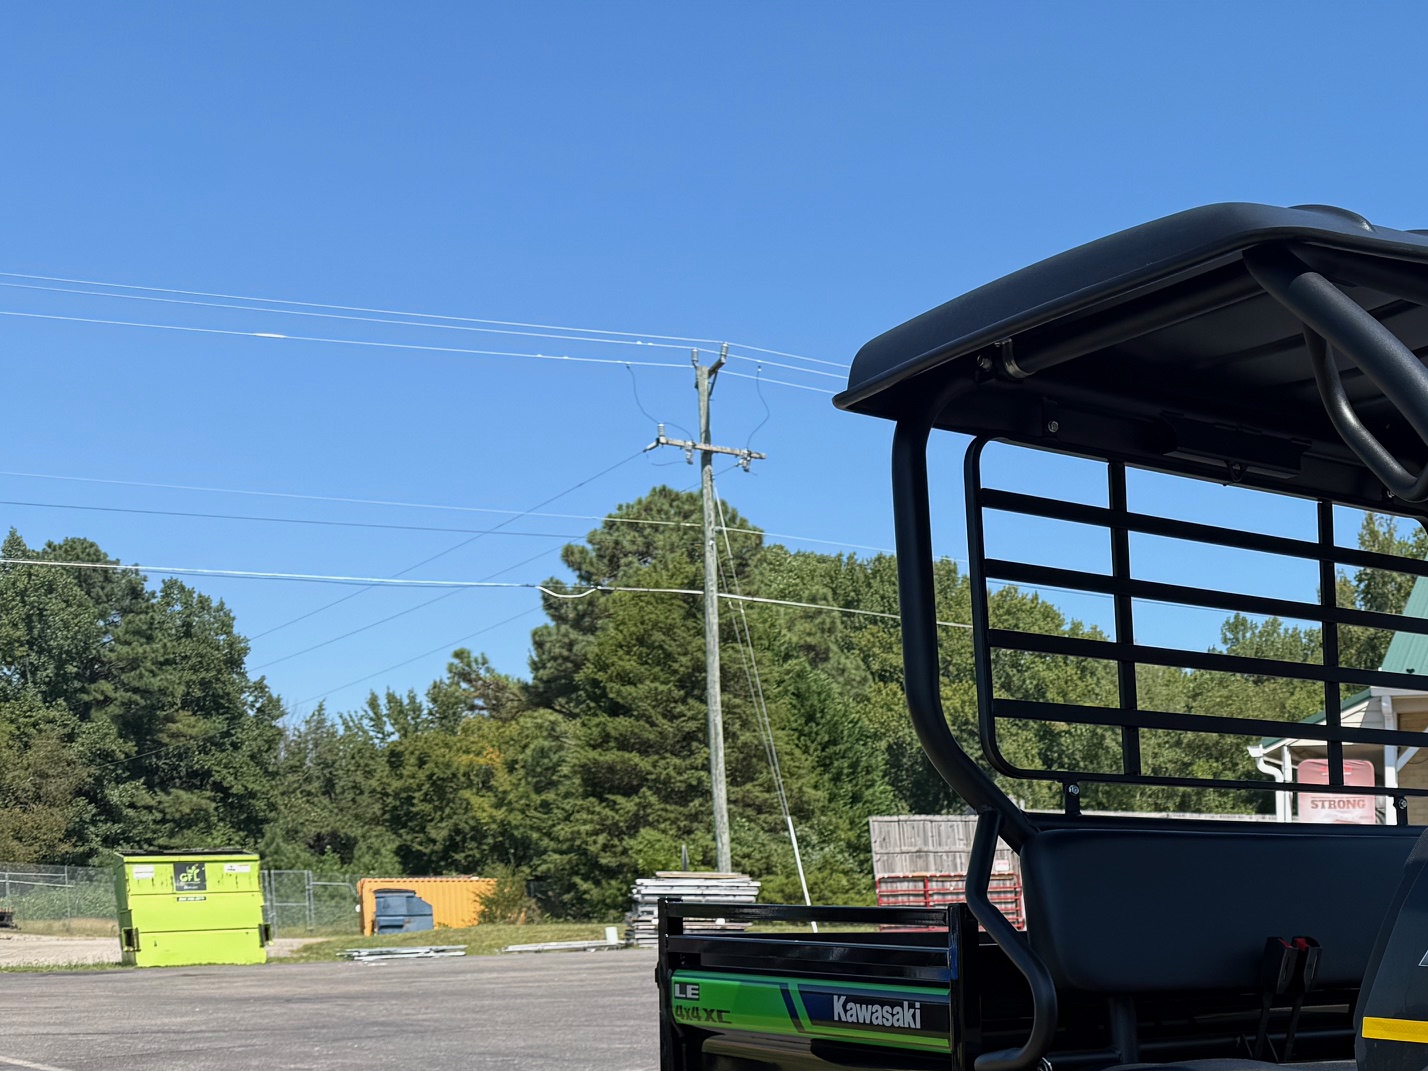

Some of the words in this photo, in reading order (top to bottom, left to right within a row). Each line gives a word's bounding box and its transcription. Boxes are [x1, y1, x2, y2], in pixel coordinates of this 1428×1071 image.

[1310, 799, 1366, 810] STRONG
[179, 869, 200, 882] GFL
[674, 983, 700, 999] LE
[702, 1010, 733, 1024] XC
[833, 994, 921, 1029] Kawasaki
